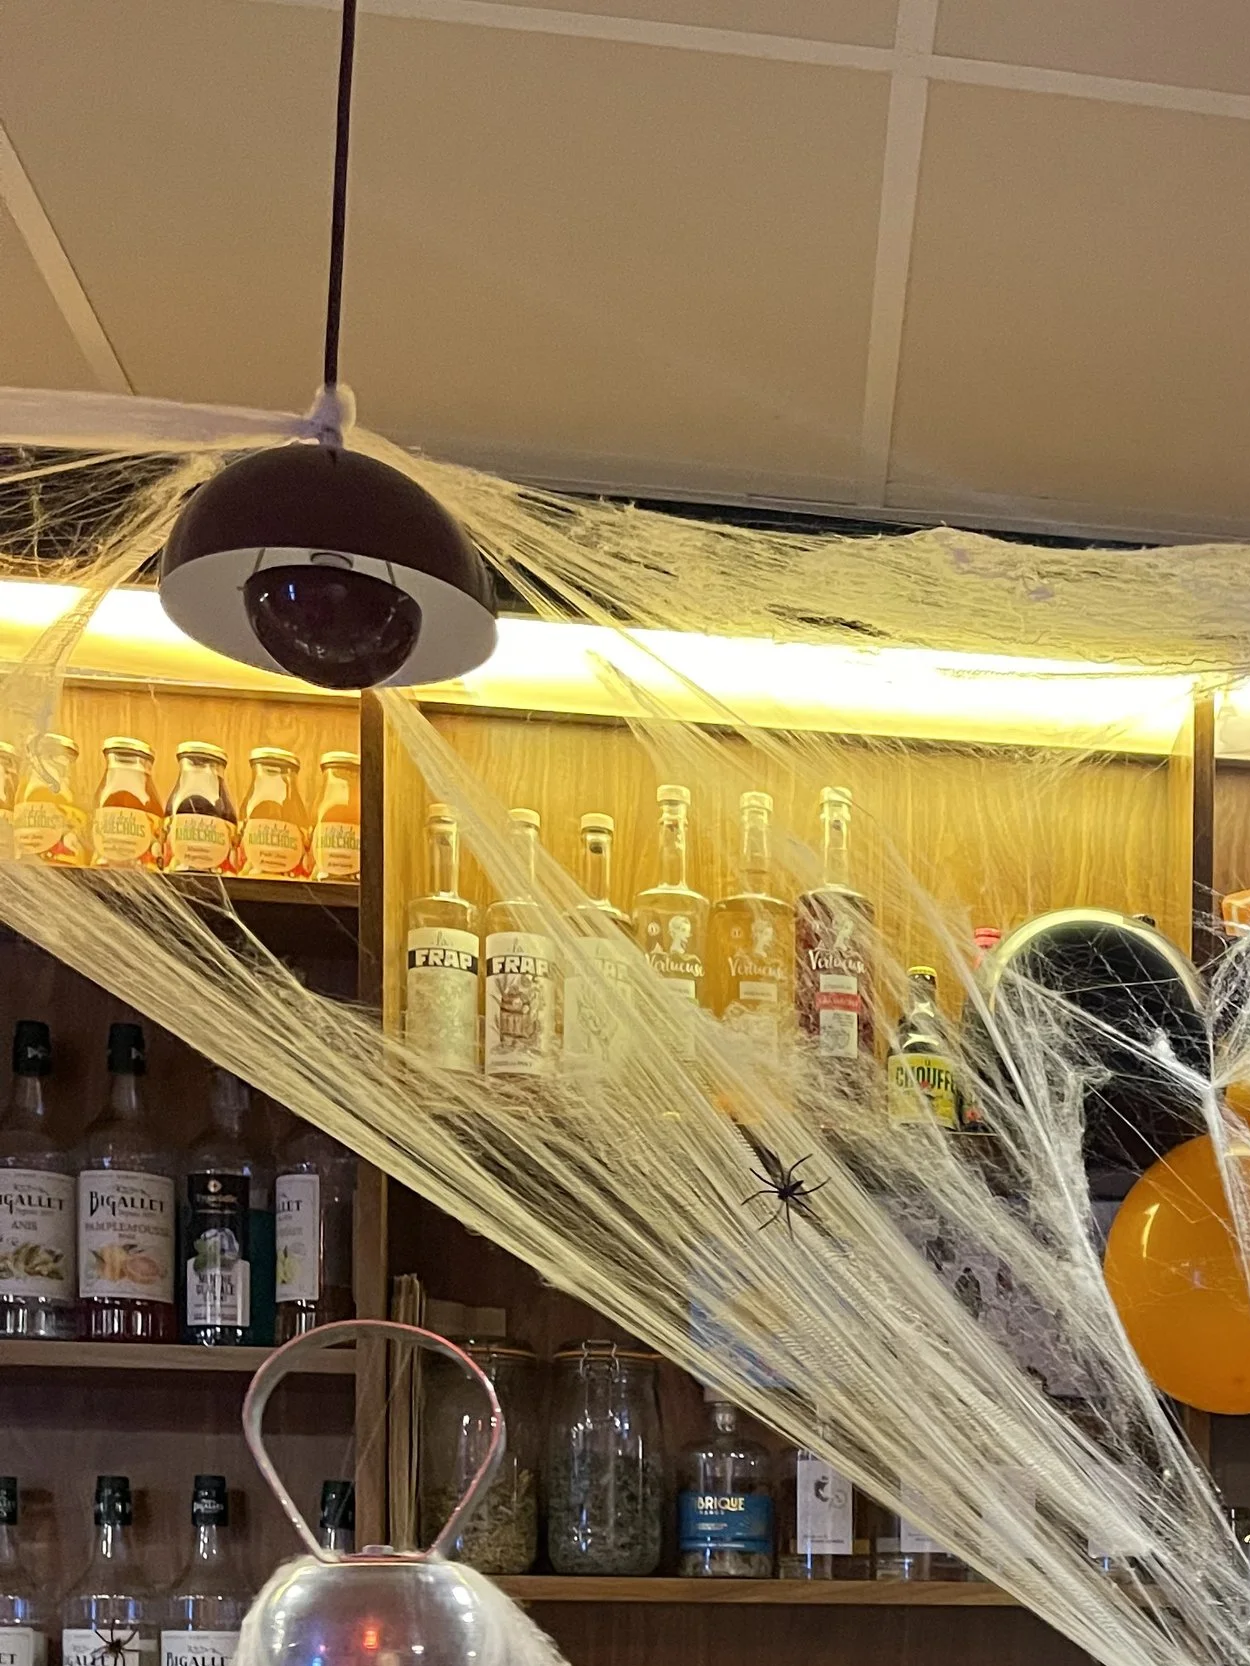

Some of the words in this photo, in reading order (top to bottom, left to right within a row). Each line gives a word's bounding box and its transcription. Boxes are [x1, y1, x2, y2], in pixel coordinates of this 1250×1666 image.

[415, 948, 473, 971] FRAP
[493, 956, 549, 978] FRAP
[90, 1191, 164, 1217] BIGALLET
